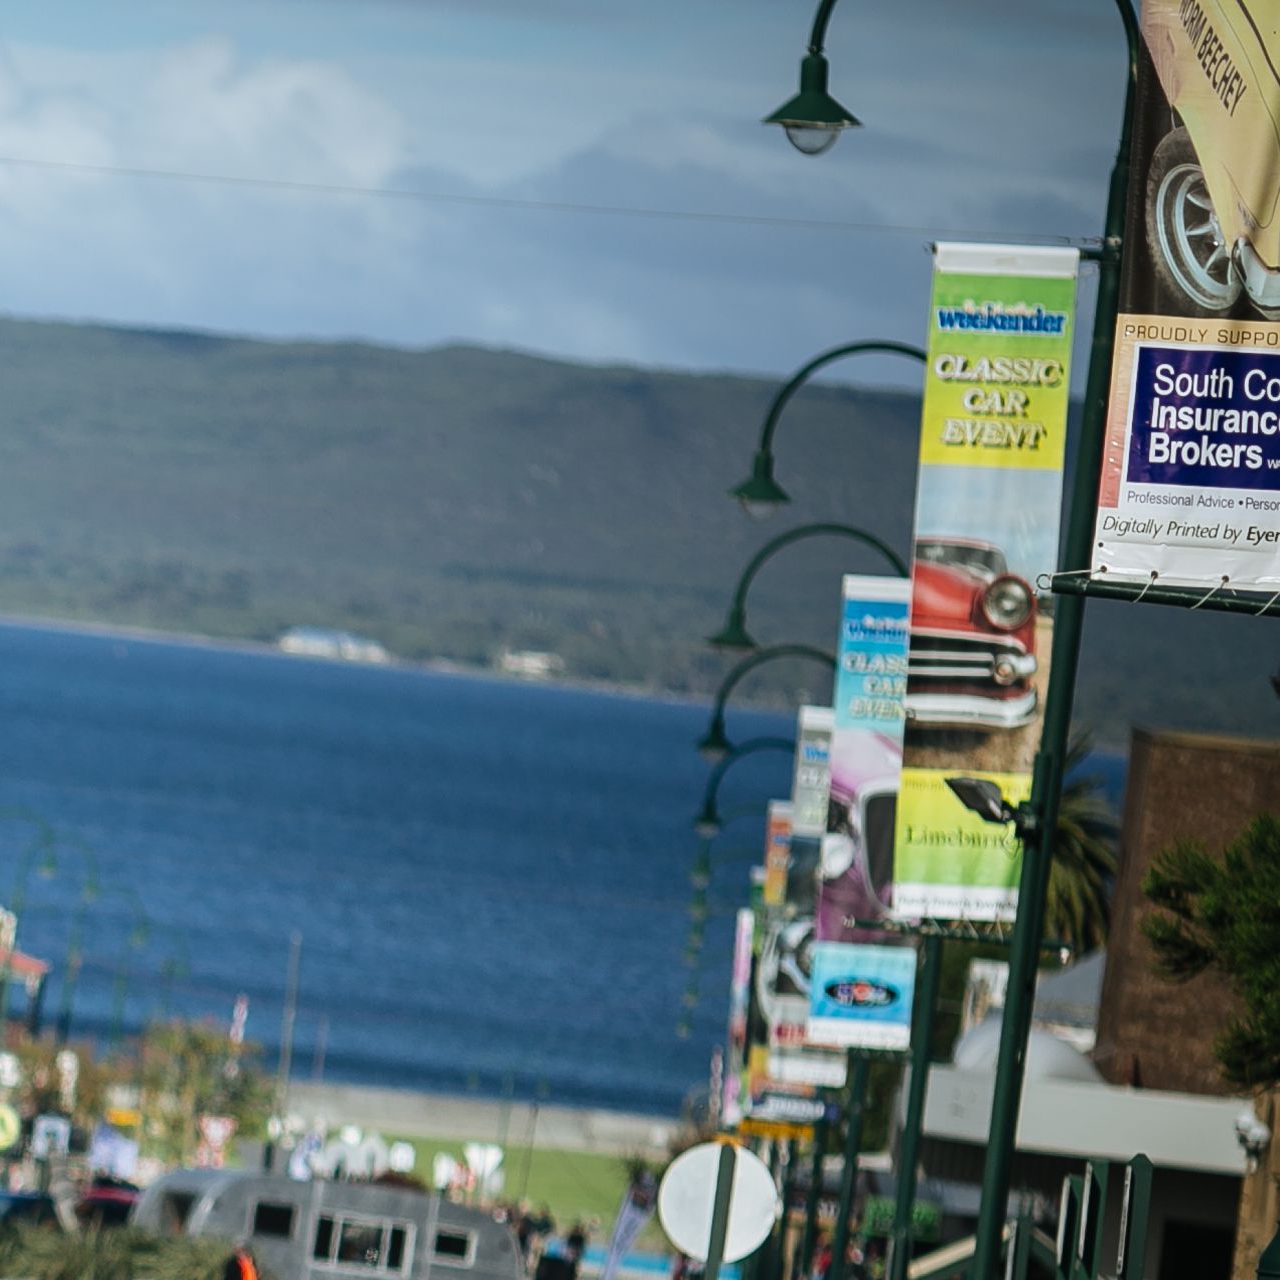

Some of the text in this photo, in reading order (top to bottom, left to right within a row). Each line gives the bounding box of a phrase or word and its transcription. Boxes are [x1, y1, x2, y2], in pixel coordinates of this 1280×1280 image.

[1197, 25, 1247, 117] BEECHEY
[1124, 324, 1279, 346] PROUDLY SUPPO
[935, 353, 1063, 388] CLASSIC
[1153, 363, 1280, 402] South Co
[962, 386, 1029, 417] CAR
[1150, 397, 1280, 436] Insuranc
[942, 418, 1047, 450] EVENT
[1148, 432, 1263, 470] Brokers
[1127, 490, 1194, 507] Professional
[1197, 494, 1234, 508] Advice
[1102, 515, 1280, 546] Digitally Printed by Eyer
